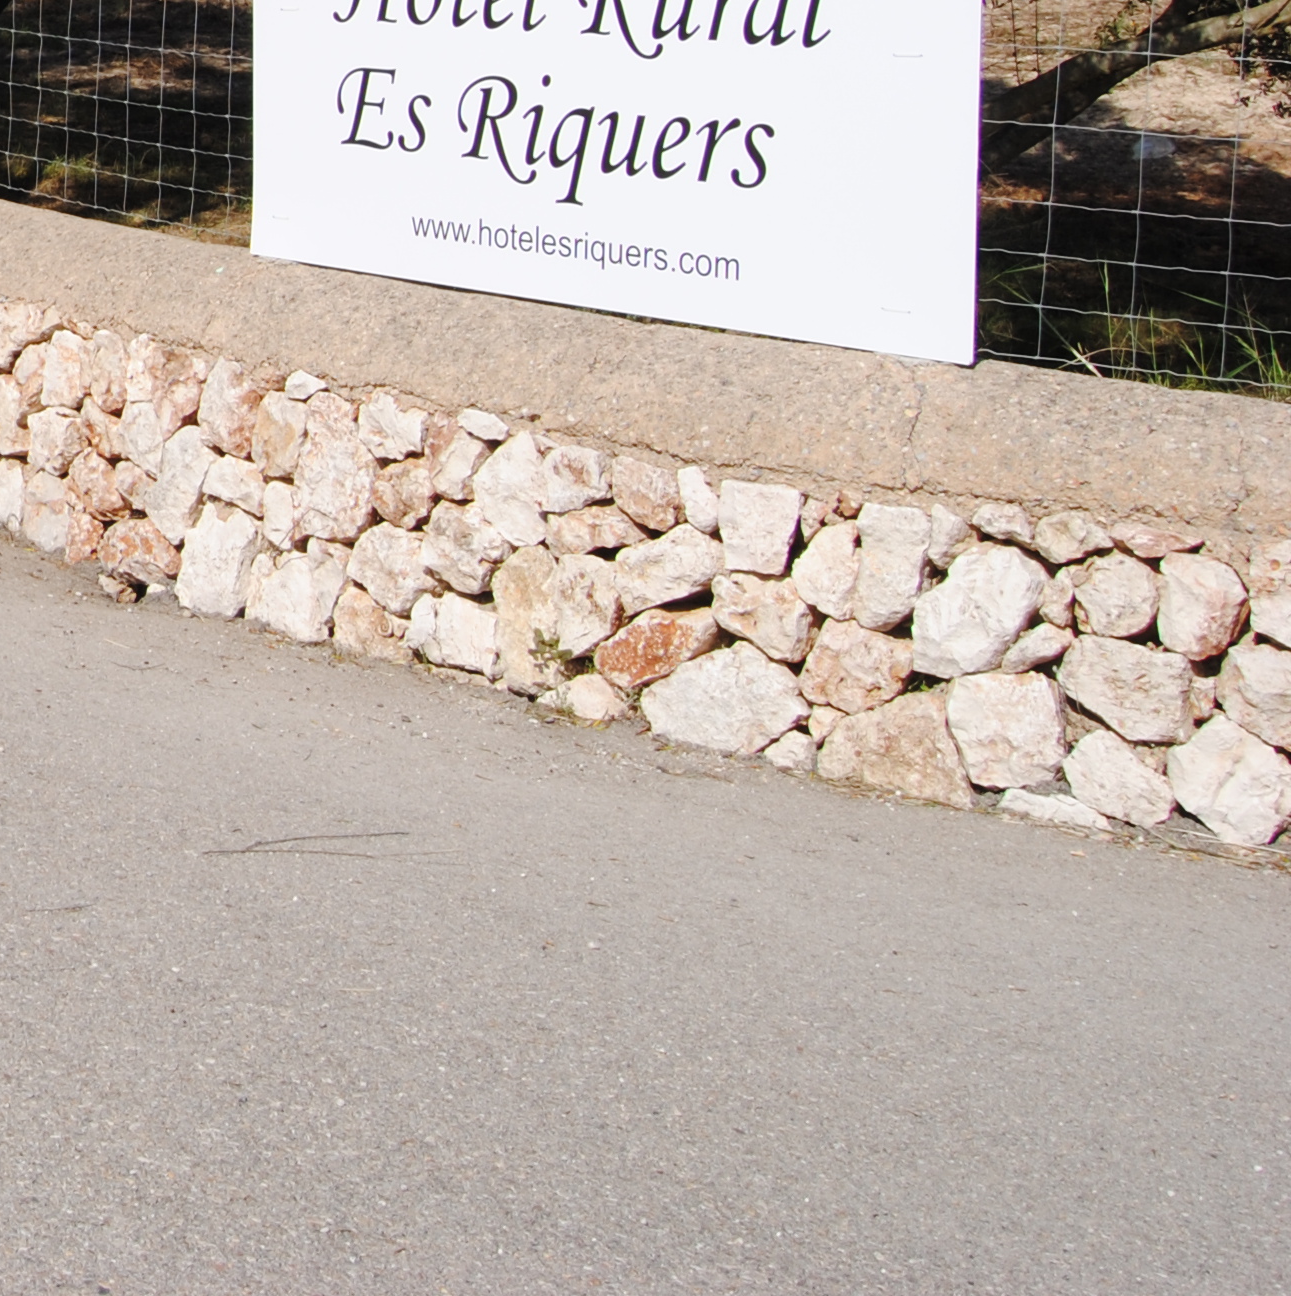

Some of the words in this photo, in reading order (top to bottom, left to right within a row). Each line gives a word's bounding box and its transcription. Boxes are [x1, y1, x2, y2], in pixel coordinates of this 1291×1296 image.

[337, 67, 432, 153] Es
[457, 74, 775, 206] Riquers
[411, 215, 740, 281] www.hotelesriquers.com
